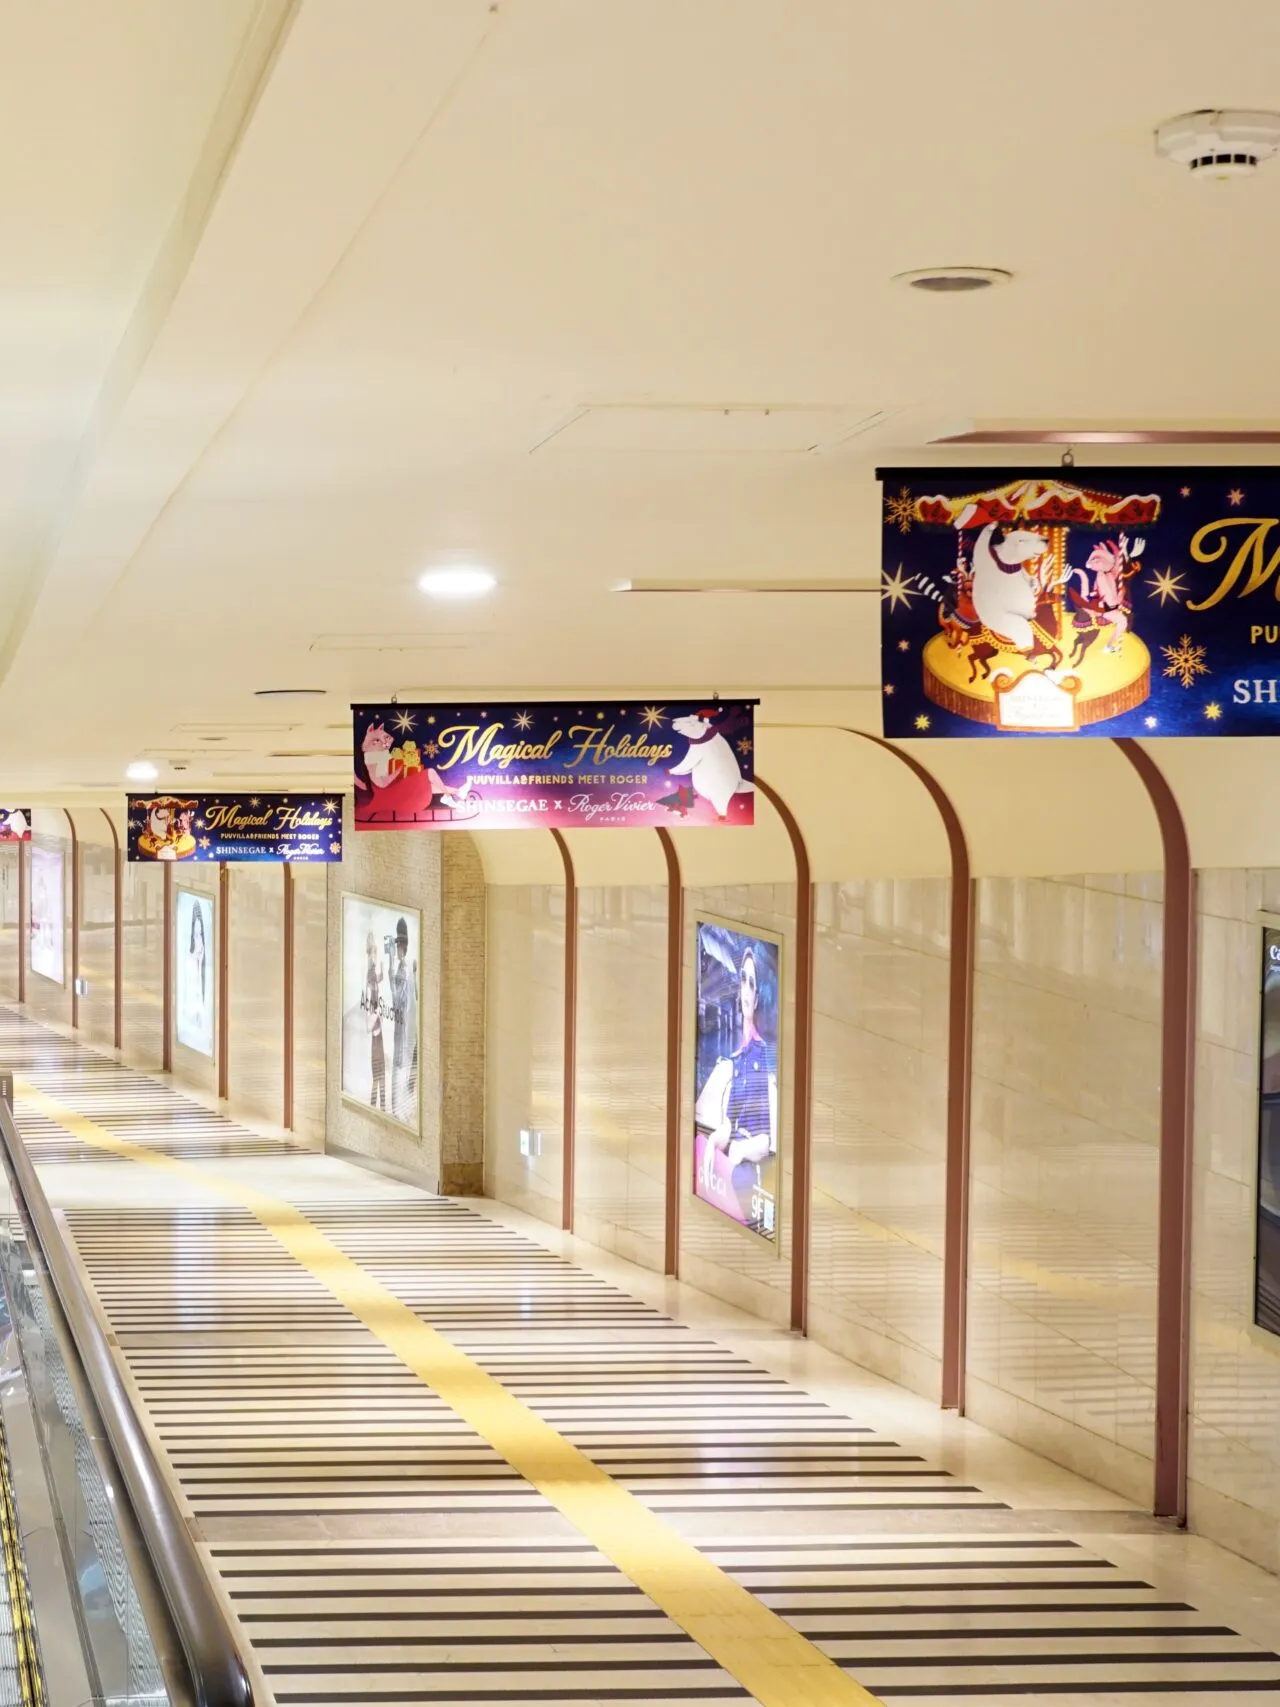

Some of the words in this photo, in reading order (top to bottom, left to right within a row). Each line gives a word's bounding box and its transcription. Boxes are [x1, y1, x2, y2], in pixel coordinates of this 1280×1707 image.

[1186, 517, 1280, 611] M
[1251, 625, 1280, 644] PU
[436, 722, 563, 770] Magical
[564, 724, 673, 768] Holidays
[578, 774, 605, 784] MEET
[610, 774, 648, 784] ROGER
[205, 804, 274, 831] Magical
[273, 806, 333, 831] Holidays
[568, 794, 612, 821] Roger
[610, 792, 657, 812] Vivier
[216, 846, 267, 855] SHINSEGAE
